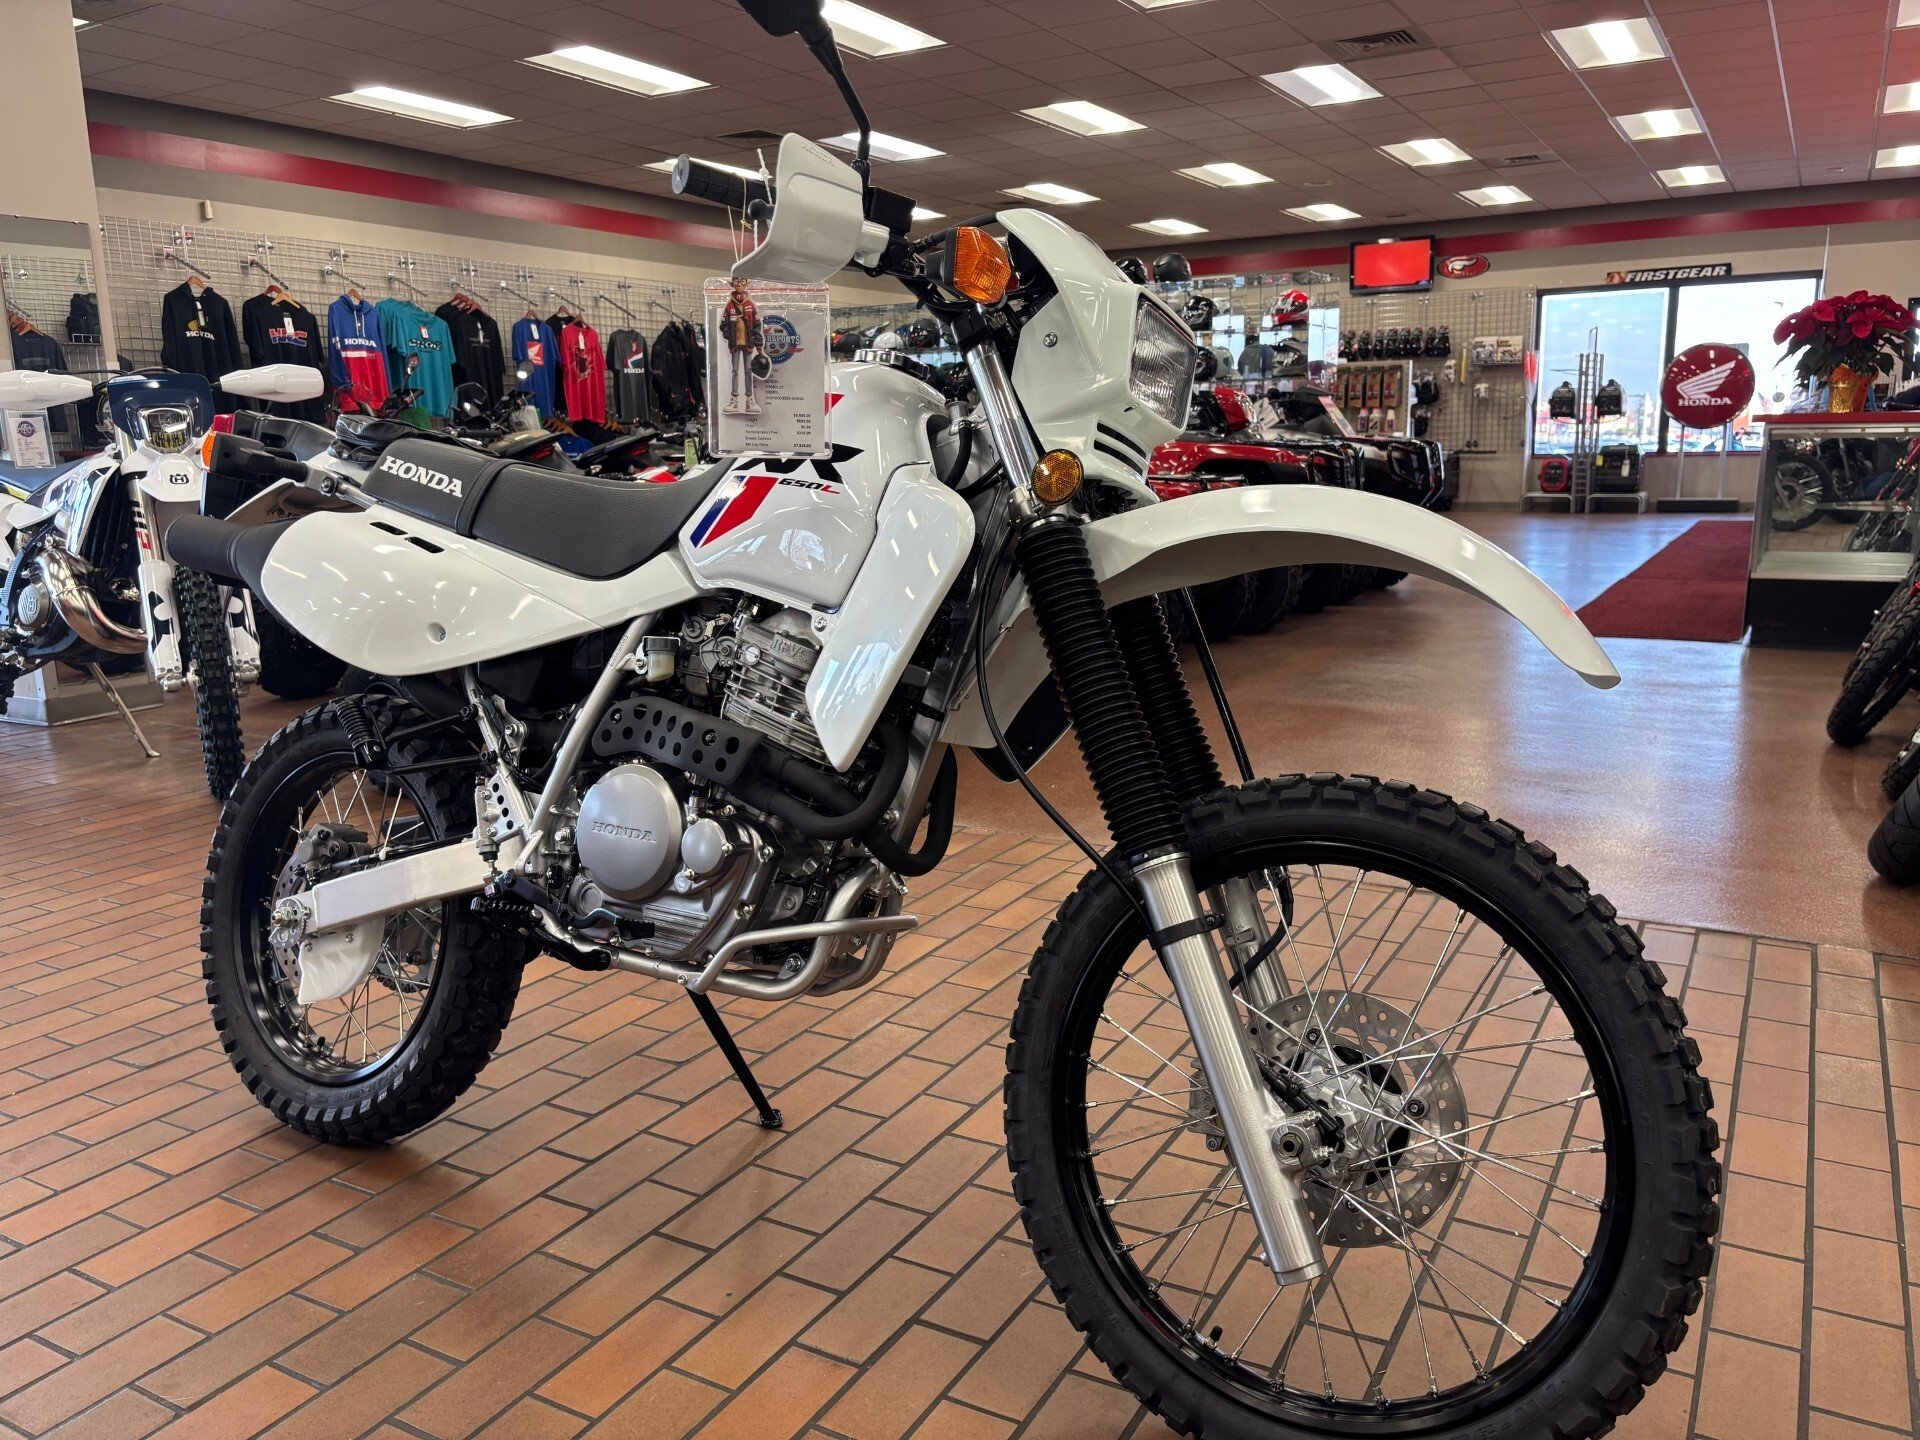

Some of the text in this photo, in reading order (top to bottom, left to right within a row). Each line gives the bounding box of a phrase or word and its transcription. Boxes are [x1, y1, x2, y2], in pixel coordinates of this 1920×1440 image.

[1624, 265, 1727, 283] FIRSTGEAR
[344, 338, 378, 348] HONDA
[765, 335, 801, 345] RSPORTS
[1677, 396, 1733, 408] HONDA
[379, 455, 463, 498] HONDA
[778, 477, 841, 495] 650L
[773, 637, 811, 663] RFVC
[591, 820, 657, 844] HONDA
